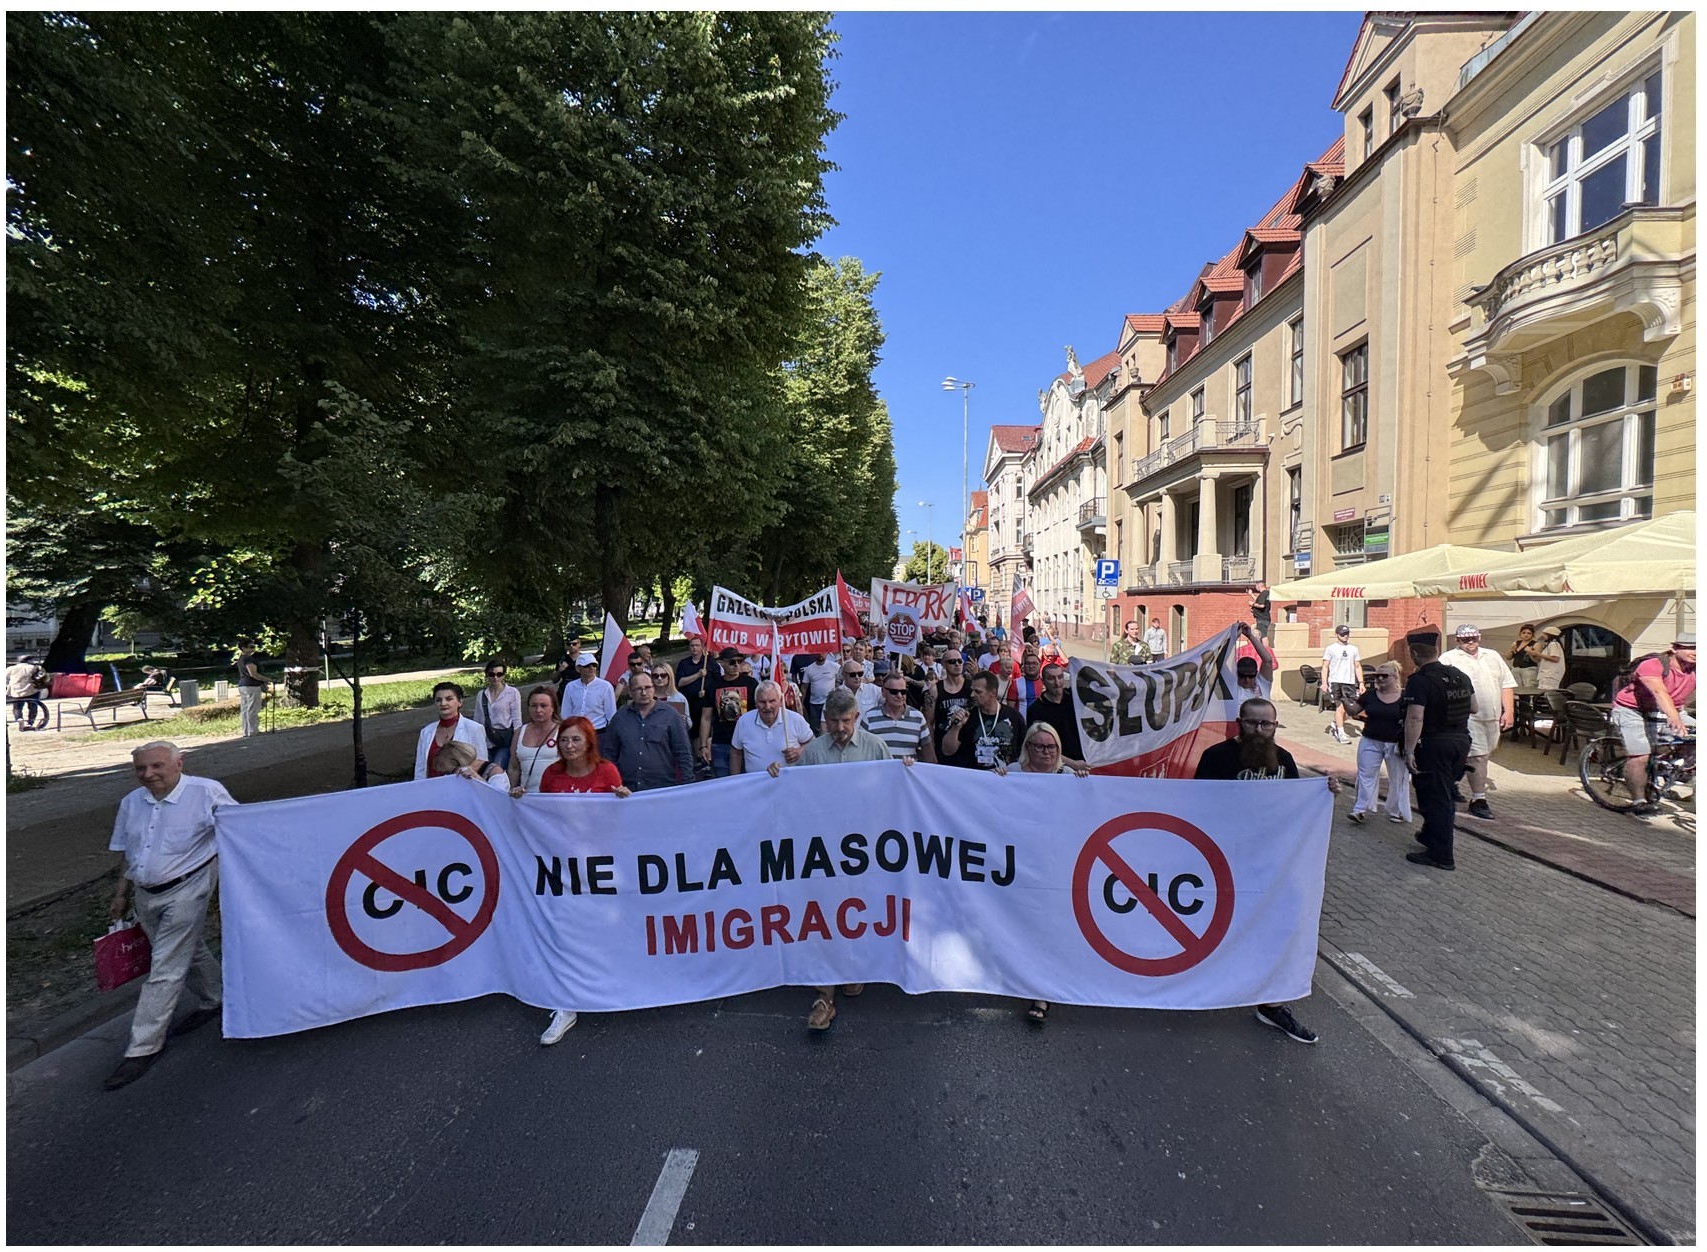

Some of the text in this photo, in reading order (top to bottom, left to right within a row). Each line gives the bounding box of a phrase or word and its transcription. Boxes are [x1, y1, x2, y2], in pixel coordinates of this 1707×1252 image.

[1101, 562, 1115, 578] P
[1459, 573, 1488, 590] ŻYWIEC
[973, 590, 980, 599] P
[1331, 586, 1366, 598] ŻYWIEC
[717, 594, 767, 620] GAZETA
[786, 594, 833, 621] POLSKA
[713, 629, 836, 648] KLUB W BYTOWIE
[889, 624, 915, 636] STOP
[536, 830, 1016, 896] NIE DLA MASOWEJ
[646, 894, 910, 956] IMIGRACJI
